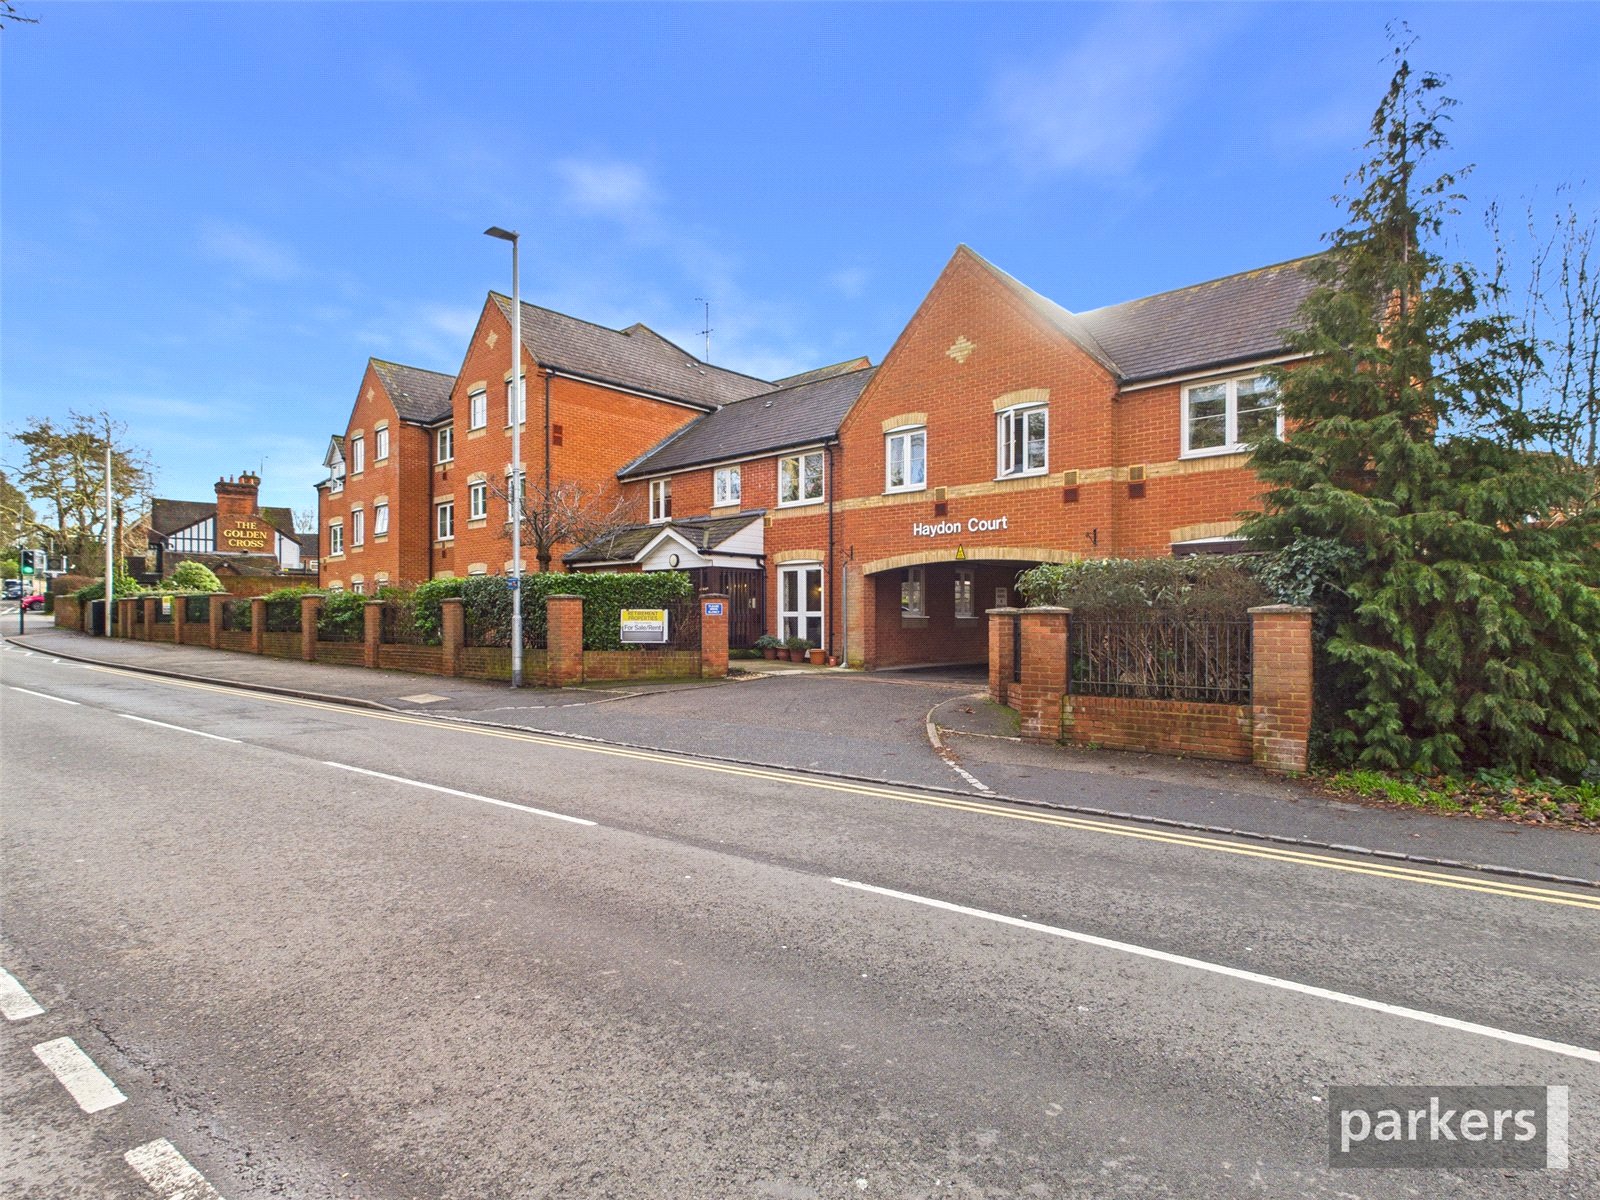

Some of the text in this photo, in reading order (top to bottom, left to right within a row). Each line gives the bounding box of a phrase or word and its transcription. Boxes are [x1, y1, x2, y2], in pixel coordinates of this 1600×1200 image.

[235, 521, 257, 529] THE
[913, 516, 1008, 537] Haydon Court
[223, 529, 267, 539] GOLDEN
[228, 538, 264, 548] CROSS
